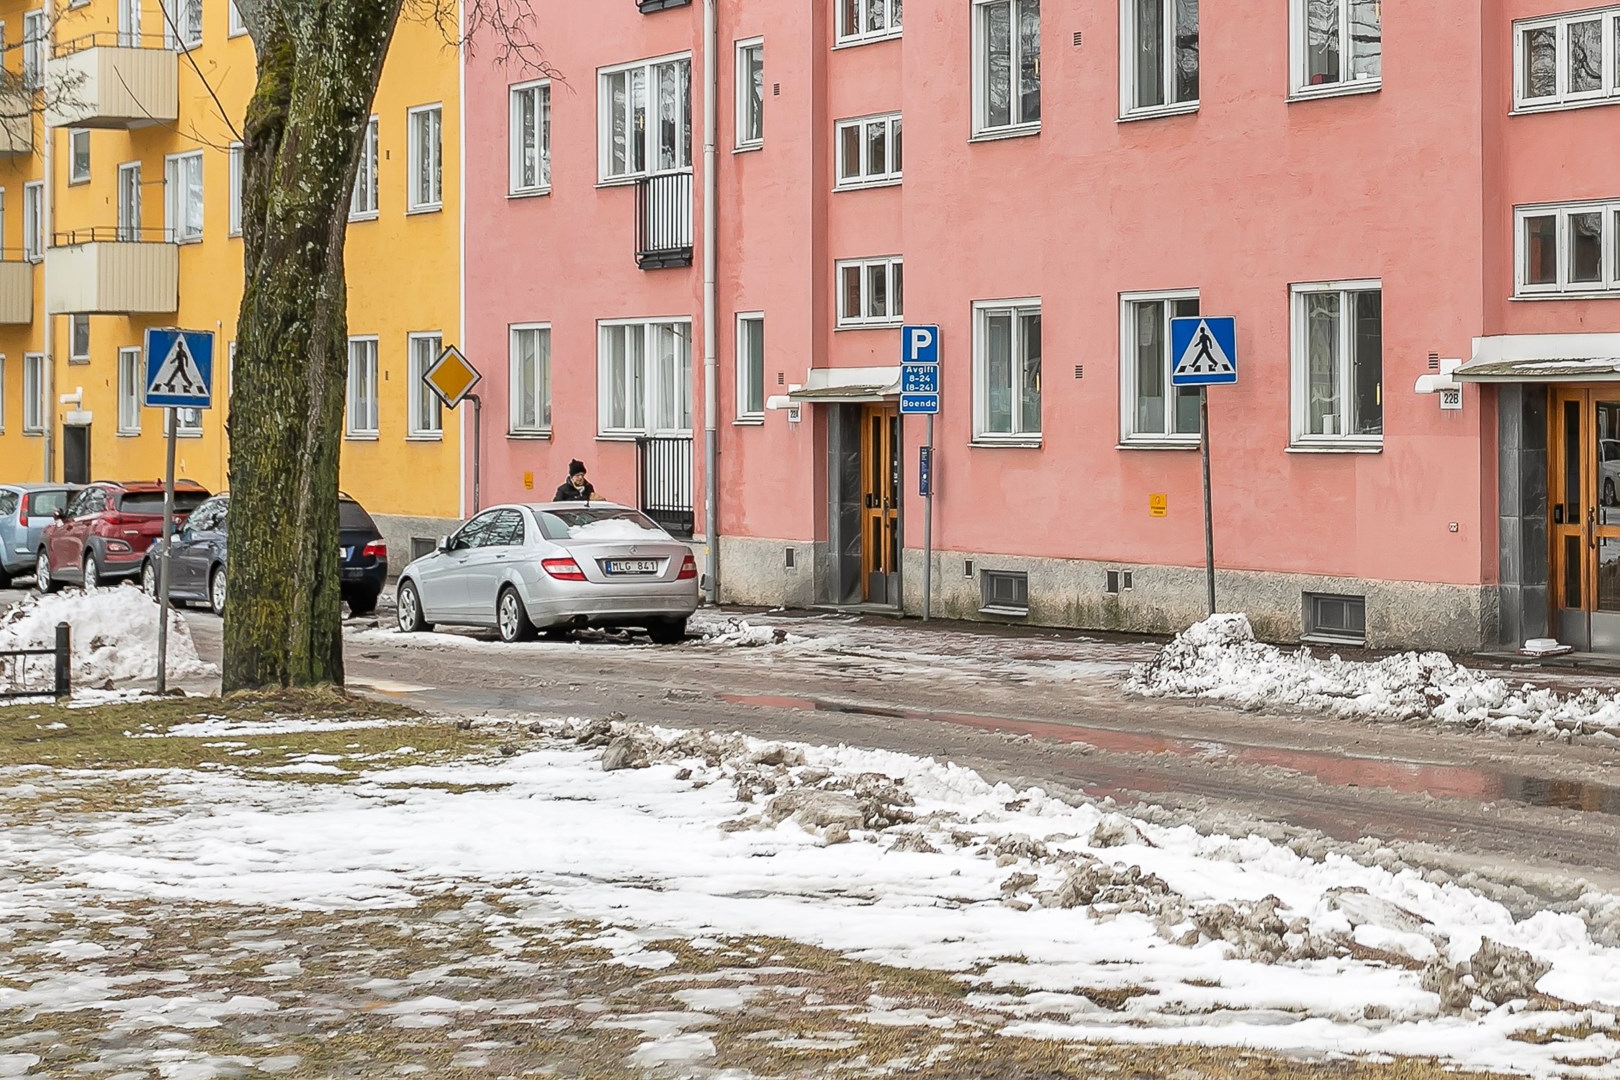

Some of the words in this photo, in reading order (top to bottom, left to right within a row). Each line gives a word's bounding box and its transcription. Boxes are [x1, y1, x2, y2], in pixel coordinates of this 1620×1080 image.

[911, 329, 932, 360] P
[906, 366, 934, 375] Avgift
[909, 374, 931, 383] 8-24
[906, 383, 934, 392] (8-24)
[1444, 393, 1459, 404] 22B
[902, 399, 937, 408] Boende
[612, 561, 632, 571] MLG
[637, 561, 655, 571] 841
